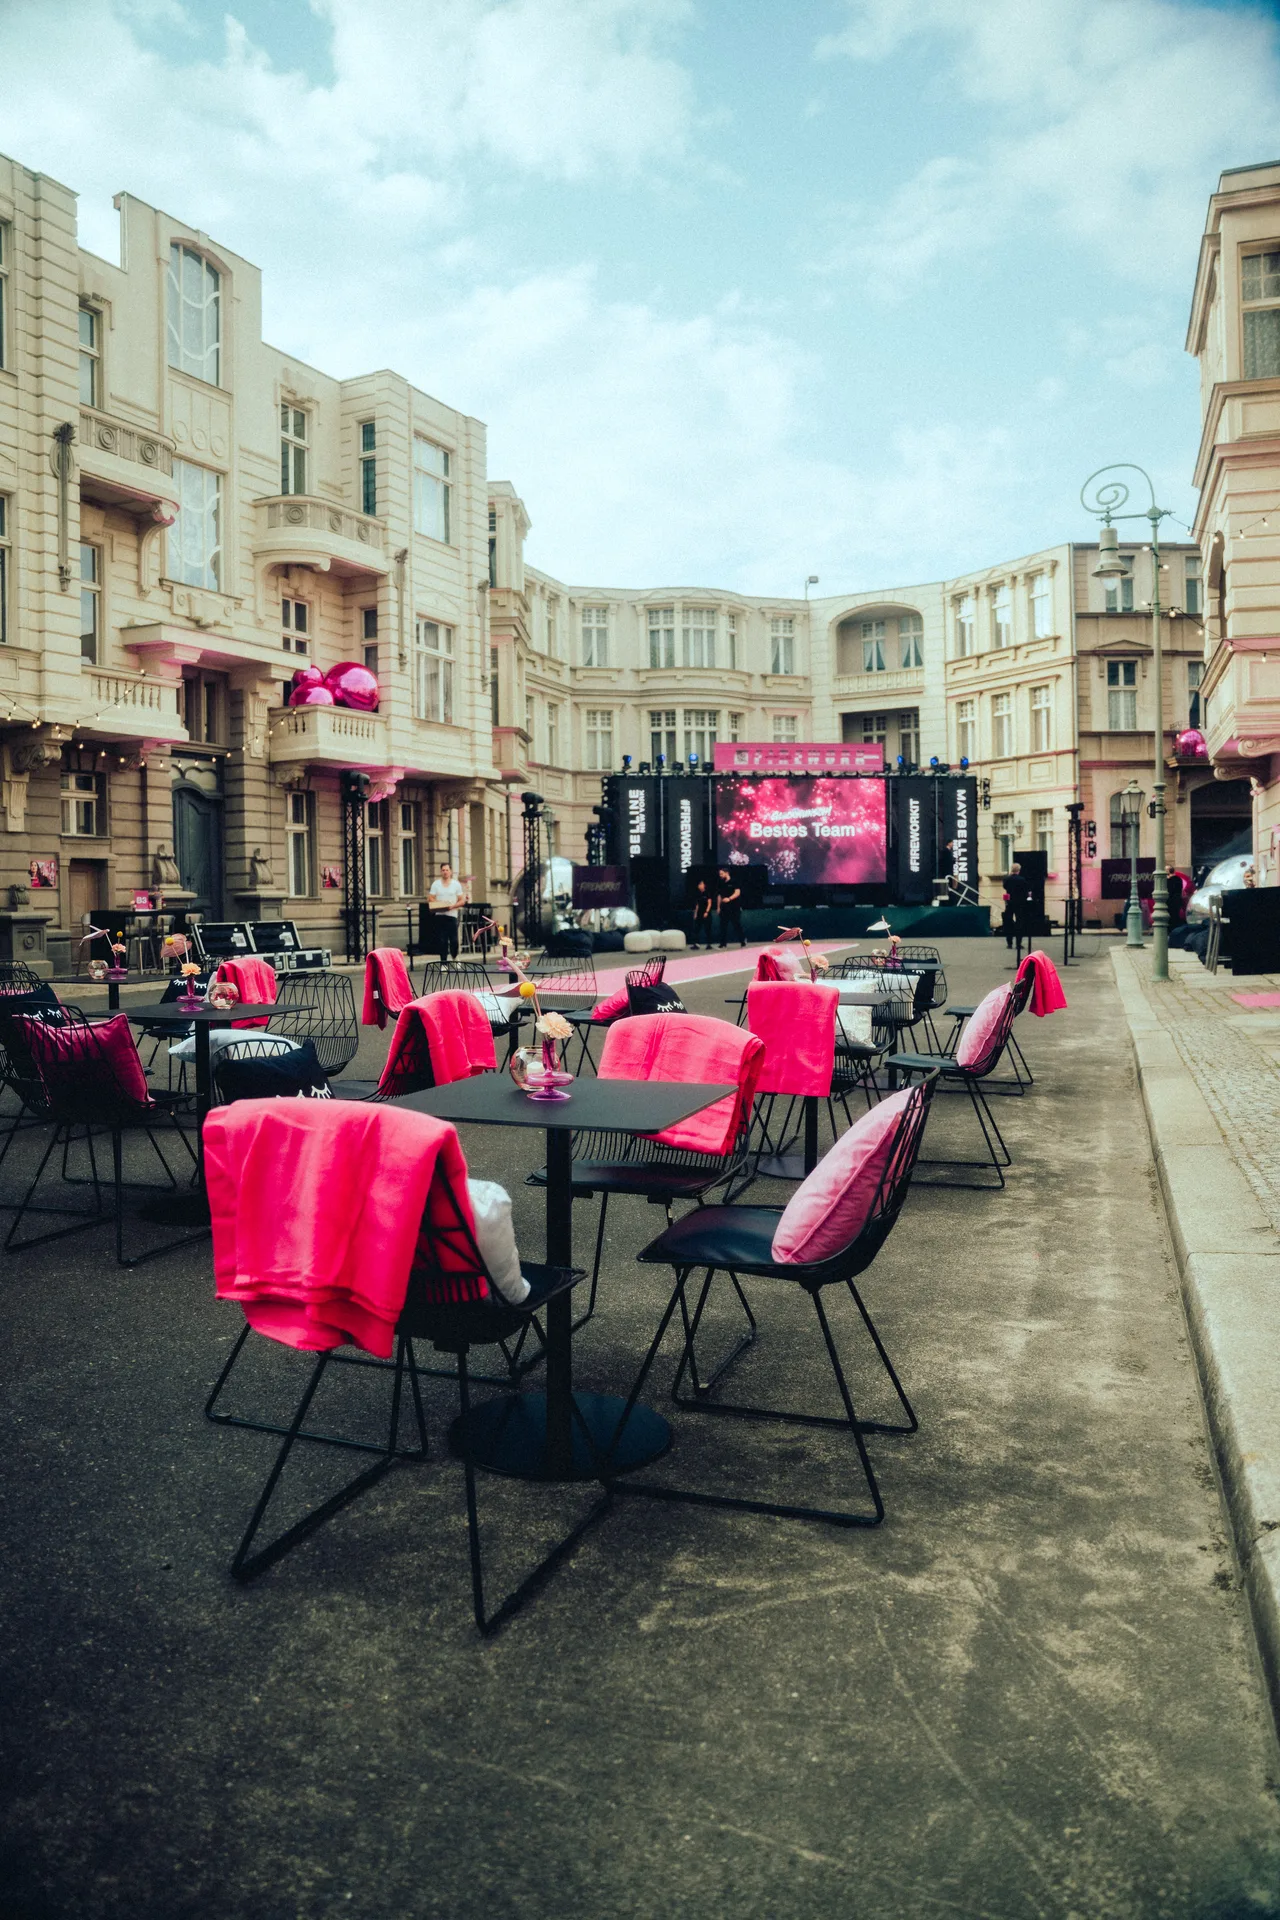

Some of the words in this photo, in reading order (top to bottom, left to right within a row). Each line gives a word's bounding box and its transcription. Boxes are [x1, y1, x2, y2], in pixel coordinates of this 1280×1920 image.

[629, 789, 641, 858] BELLINE
[750, 822, 808, 838] Bestes
[811, 822, 856, 837] Team
[909, 798, 920, 872] #FIREWORKIT
[956, 789, 968, 882] MAYBELLINE
